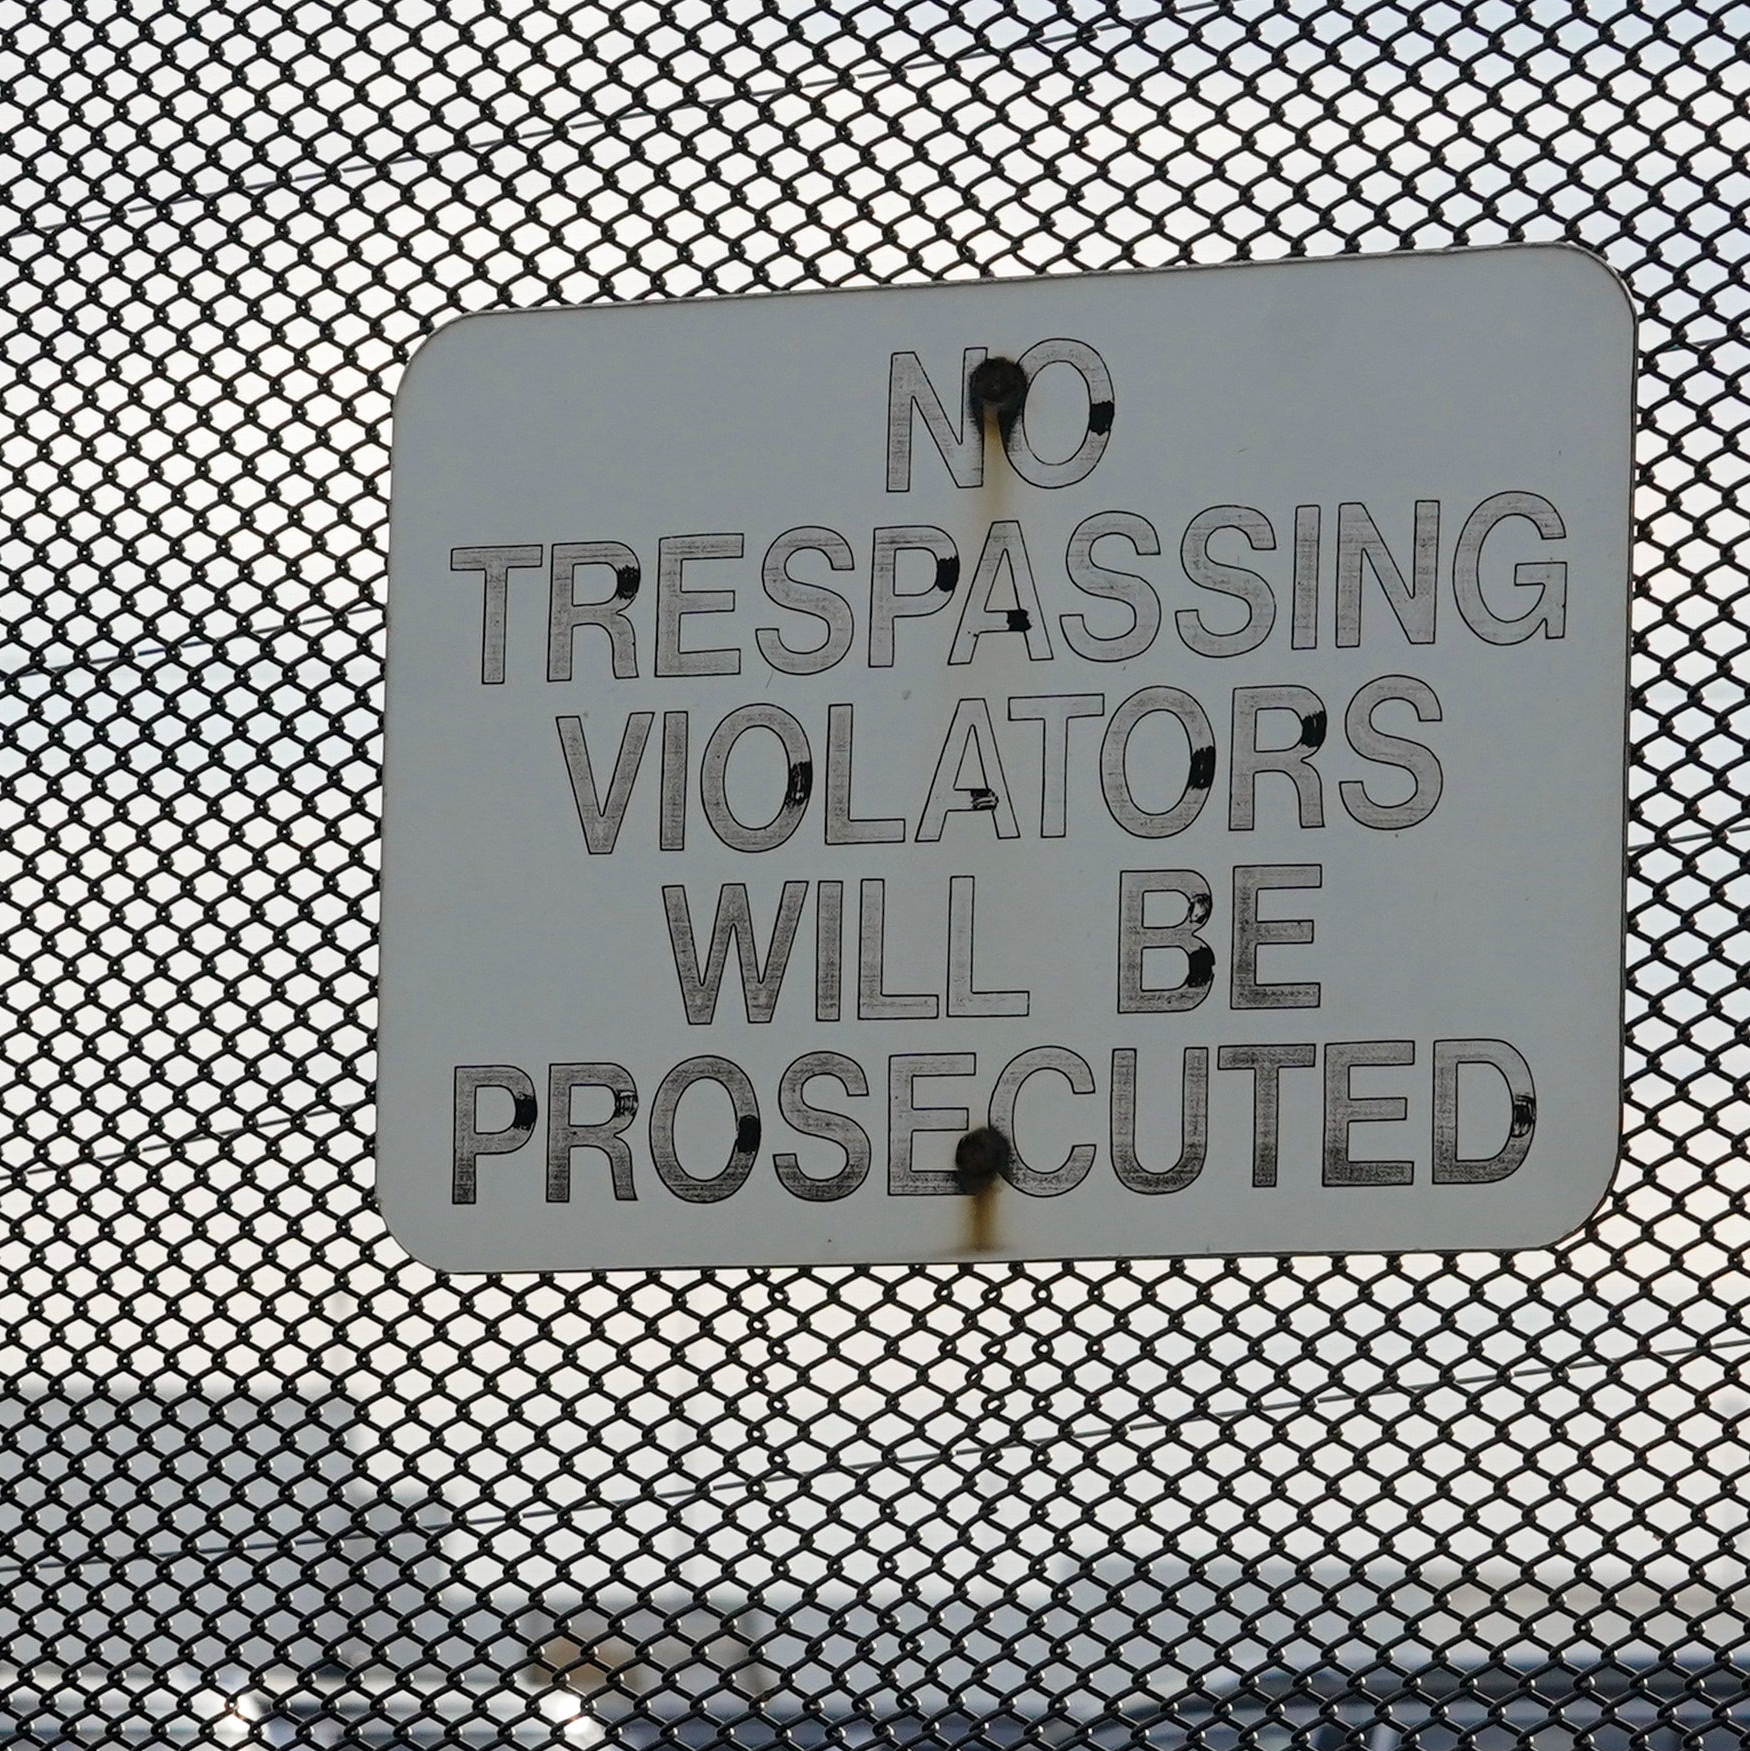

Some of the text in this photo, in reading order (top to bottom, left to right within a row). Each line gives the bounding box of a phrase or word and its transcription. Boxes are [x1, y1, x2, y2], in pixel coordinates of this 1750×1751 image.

[886, 337, 1115, 492] NO
[451, 490, 1568, 685] TRESPASSING
[555, 674, 1444, 855] VIOLATORS
[662, 865, 1323, 1025] WILL BE
[451, 1038, 1536, 1205] PROSECUTED
